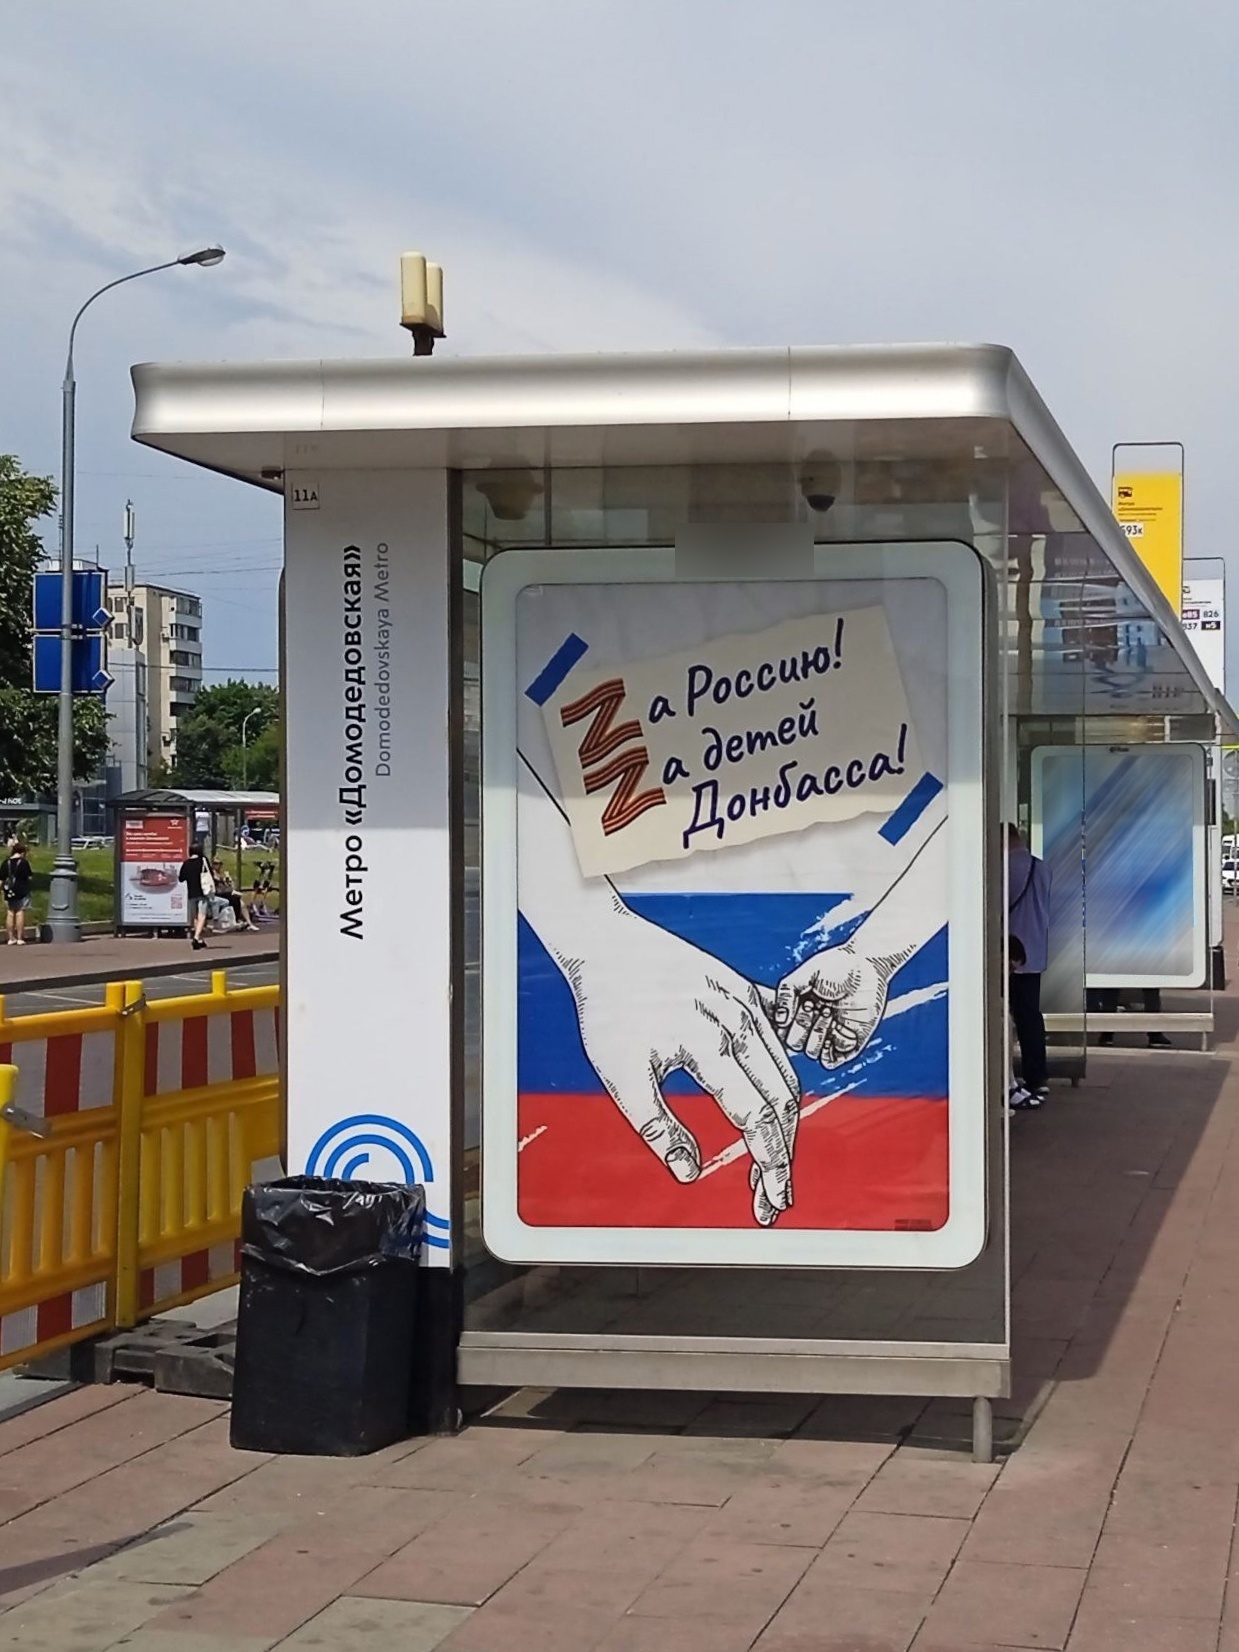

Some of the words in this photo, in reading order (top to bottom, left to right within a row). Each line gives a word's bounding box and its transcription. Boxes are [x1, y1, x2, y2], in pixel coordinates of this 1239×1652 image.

[373, 542, 389, 601] Metro
[1203, 610, 1219, 618] 826
[338, 544, 367, 825] «Домодедовская»
[373, 608, 393, 777] Domodedovskaya
[686, 617, 845, 717] Россию!
[701, 697, 819, 771] детей
[682, 723, 909, 849] Донбасса!
[339, 835, 368, 940] Метро
